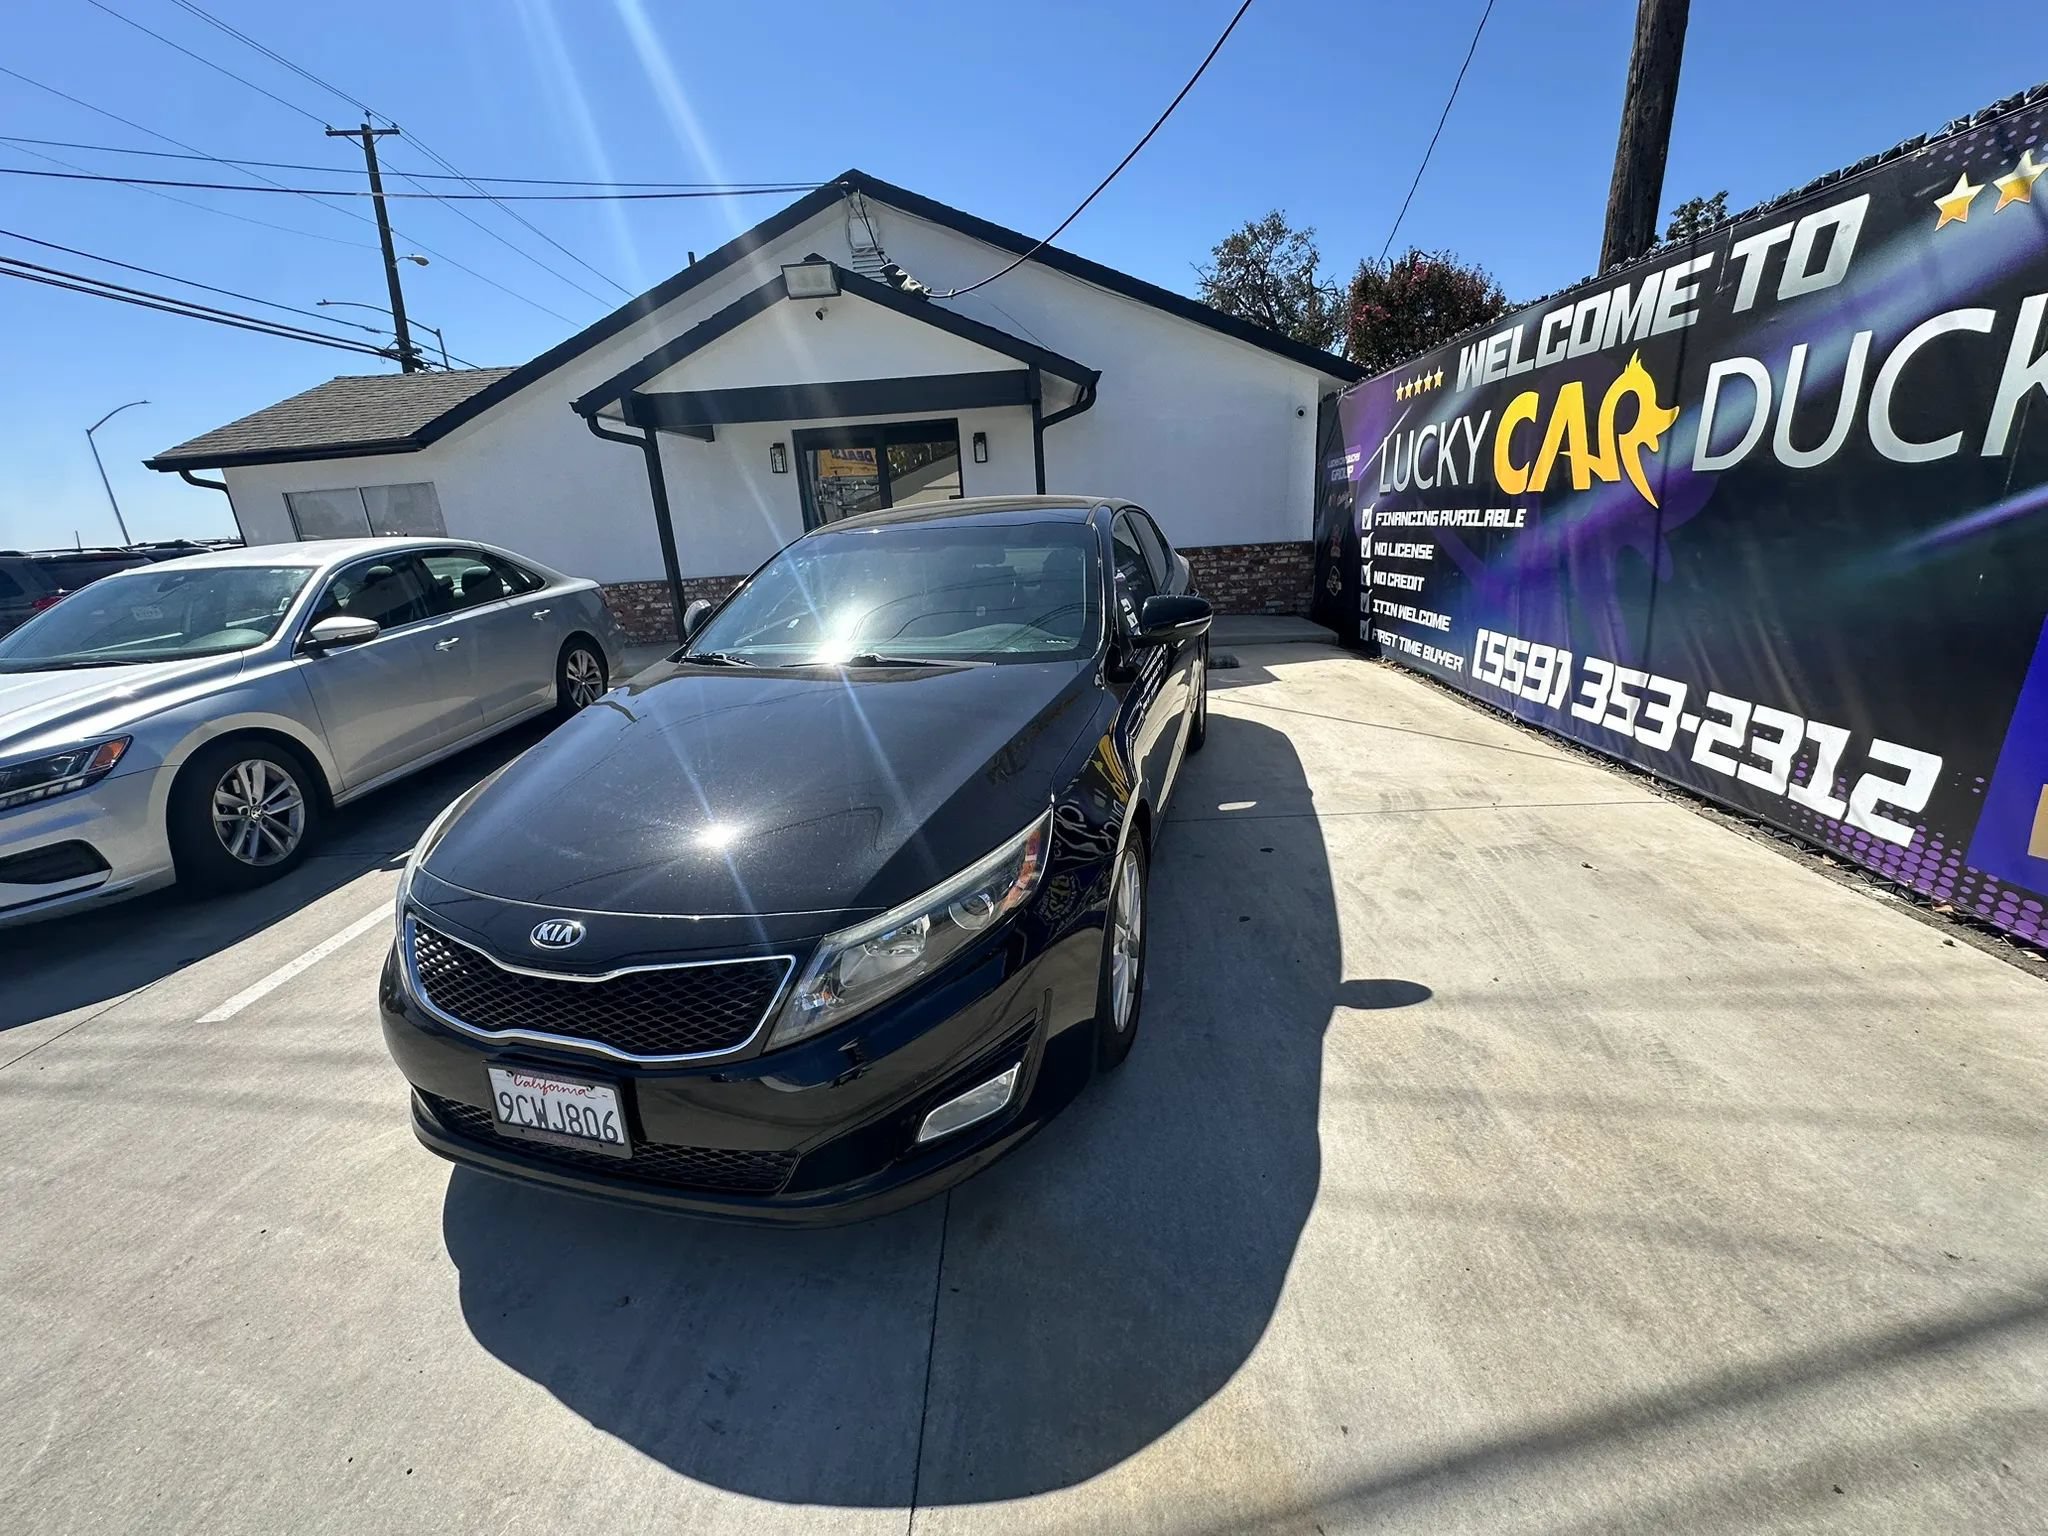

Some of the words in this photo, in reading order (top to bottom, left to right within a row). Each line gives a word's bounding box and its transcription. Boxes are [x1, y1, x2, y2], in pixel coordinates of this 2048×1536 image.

[1457, 254, 1714, 393] WELCOME
[1731, 194, 1871, 313] TO
[1378, 411, 1493, 494] LUCKY
[1493, 349, 1680, 510] CAR
[1375, 510, 1440, 527] FINANCING
[1439, 508, 1527, 528] AVAILABLE
[1374, 541, 1388, 556] NO
[1388, 543, 1435, 560] LICENSE
[1373, 570, 1386, 585] NO
[1387, 573, 1425, 592] CREDIT
[1373, 599, 1398, 618] ITIN
[1398, 604, 1452, 632] WELCOME
[1372, 627, 1398, 648] FIRST
[1398, 635, 1423, 658] TIME
[1422, 644, 1465, 673] BUYER
[1472, 627, 1573, 711] (559)
[1571, 655, 1944, 849] 353-2312
[536, 923, 573, 944] KIA
[513, 1072, 596, 1097] California
[499, 1091, 619, 1143] 9CWJ806
